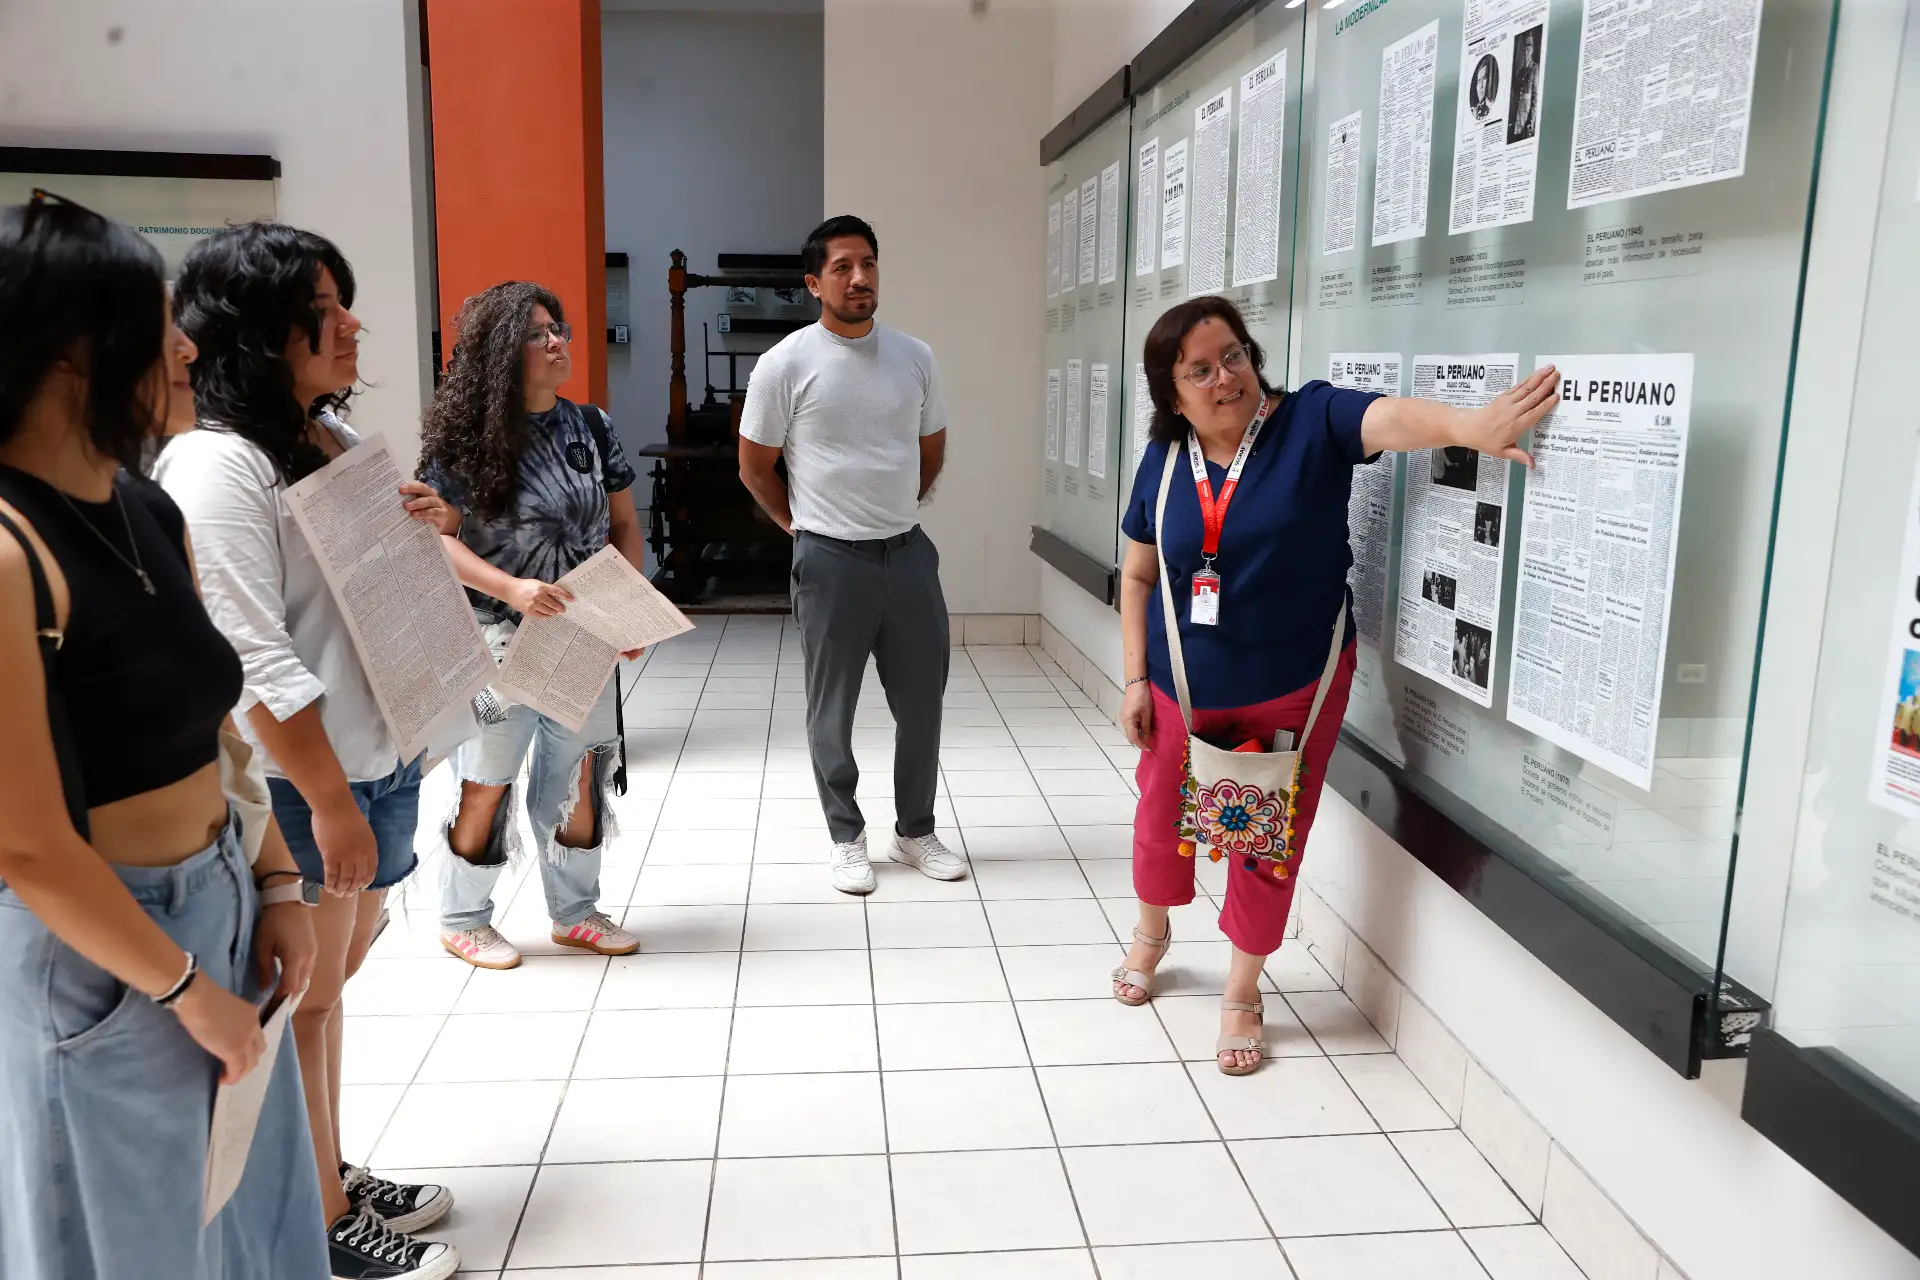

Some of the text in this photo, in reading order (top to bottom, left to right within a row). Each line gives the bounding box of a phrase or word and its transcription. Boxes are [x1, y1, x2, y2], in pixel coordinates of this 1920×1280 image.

[1335, 20, 1344, 36] LA
[1249, 76, 1254, 90] EL
[1202, 108, 1206, 120] EL
[1331, 118, 1360, 137] EL PERUANO
[1575, 142, 1616, 162] EL PERUANO
[138, 226, 188, 234] PATRIMONIO
[1587, 226, 1644, 243] EL PERUANO (1945)
[1586, 246, 1592, 255] El
[1596, 244, 1618, 254] Peruano
[1661, 234, 1683, 244] tamaño
[1688, 232, 1703, 242] para
[1456, 253, 1474, 263] PERUANO
[1585, 258, 1604, 268] abarcar
[1347, 363, 1380, 375] EL PERUANO
[1436, 365, 1485, 380] EL PERUANO
[1563, 380, 1676, 406] EL PERUANO
[1535, 431, 1549, 440] Colegio
[1558, 434, 1579, 442] Abogados
[1524, 755, 1530, 764] EL
[1531, 759, 1555, 777] PERUANO
[1522, 777, 1539, 792] nacional
[1523, 766, 1539, 780] Durante
[1547, 781, 1567, 796] gobierno
[1521, 786, 1525, 795] El
[1877, 842, 1889, 857] EL
